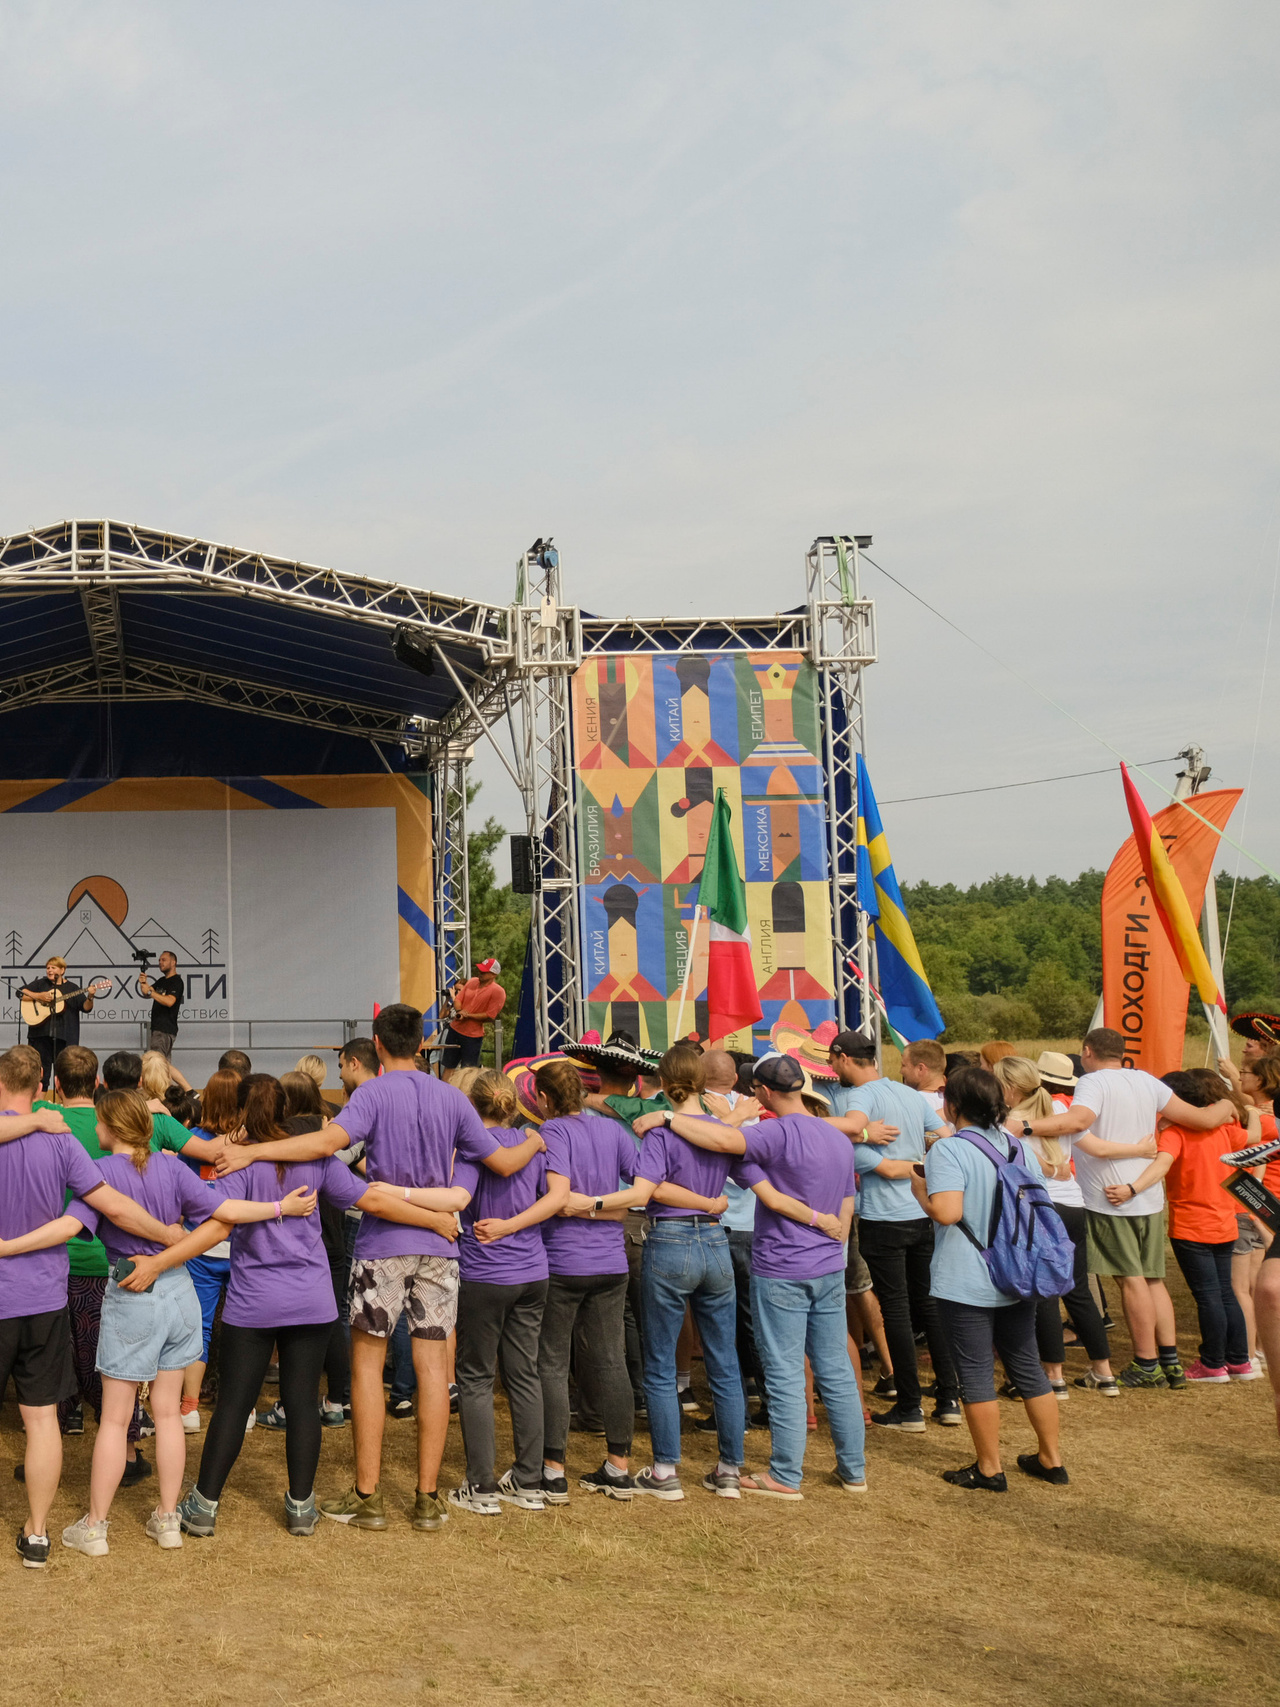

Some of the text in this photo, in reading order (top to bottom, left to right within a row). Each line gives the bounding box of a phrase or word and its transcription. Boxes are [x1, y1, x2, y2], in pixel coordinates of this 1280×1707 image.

[586, 697, 598, 742] КЕНИЯ
[665, 697, 681, 742] КИТАЙ
[749, 689, 763, 740] ЕГИПЕТ
[587, 805, 601, 876] БРАЗИЛИЯ
[756, 806, 770, 872] МЕКСИКА
[590, 930, 606, 975] КИТАЙ
[760, 919, 773, 975] АНГЛИЯ
[1121, 913, 1151, 1070] РПОХОДГИ
